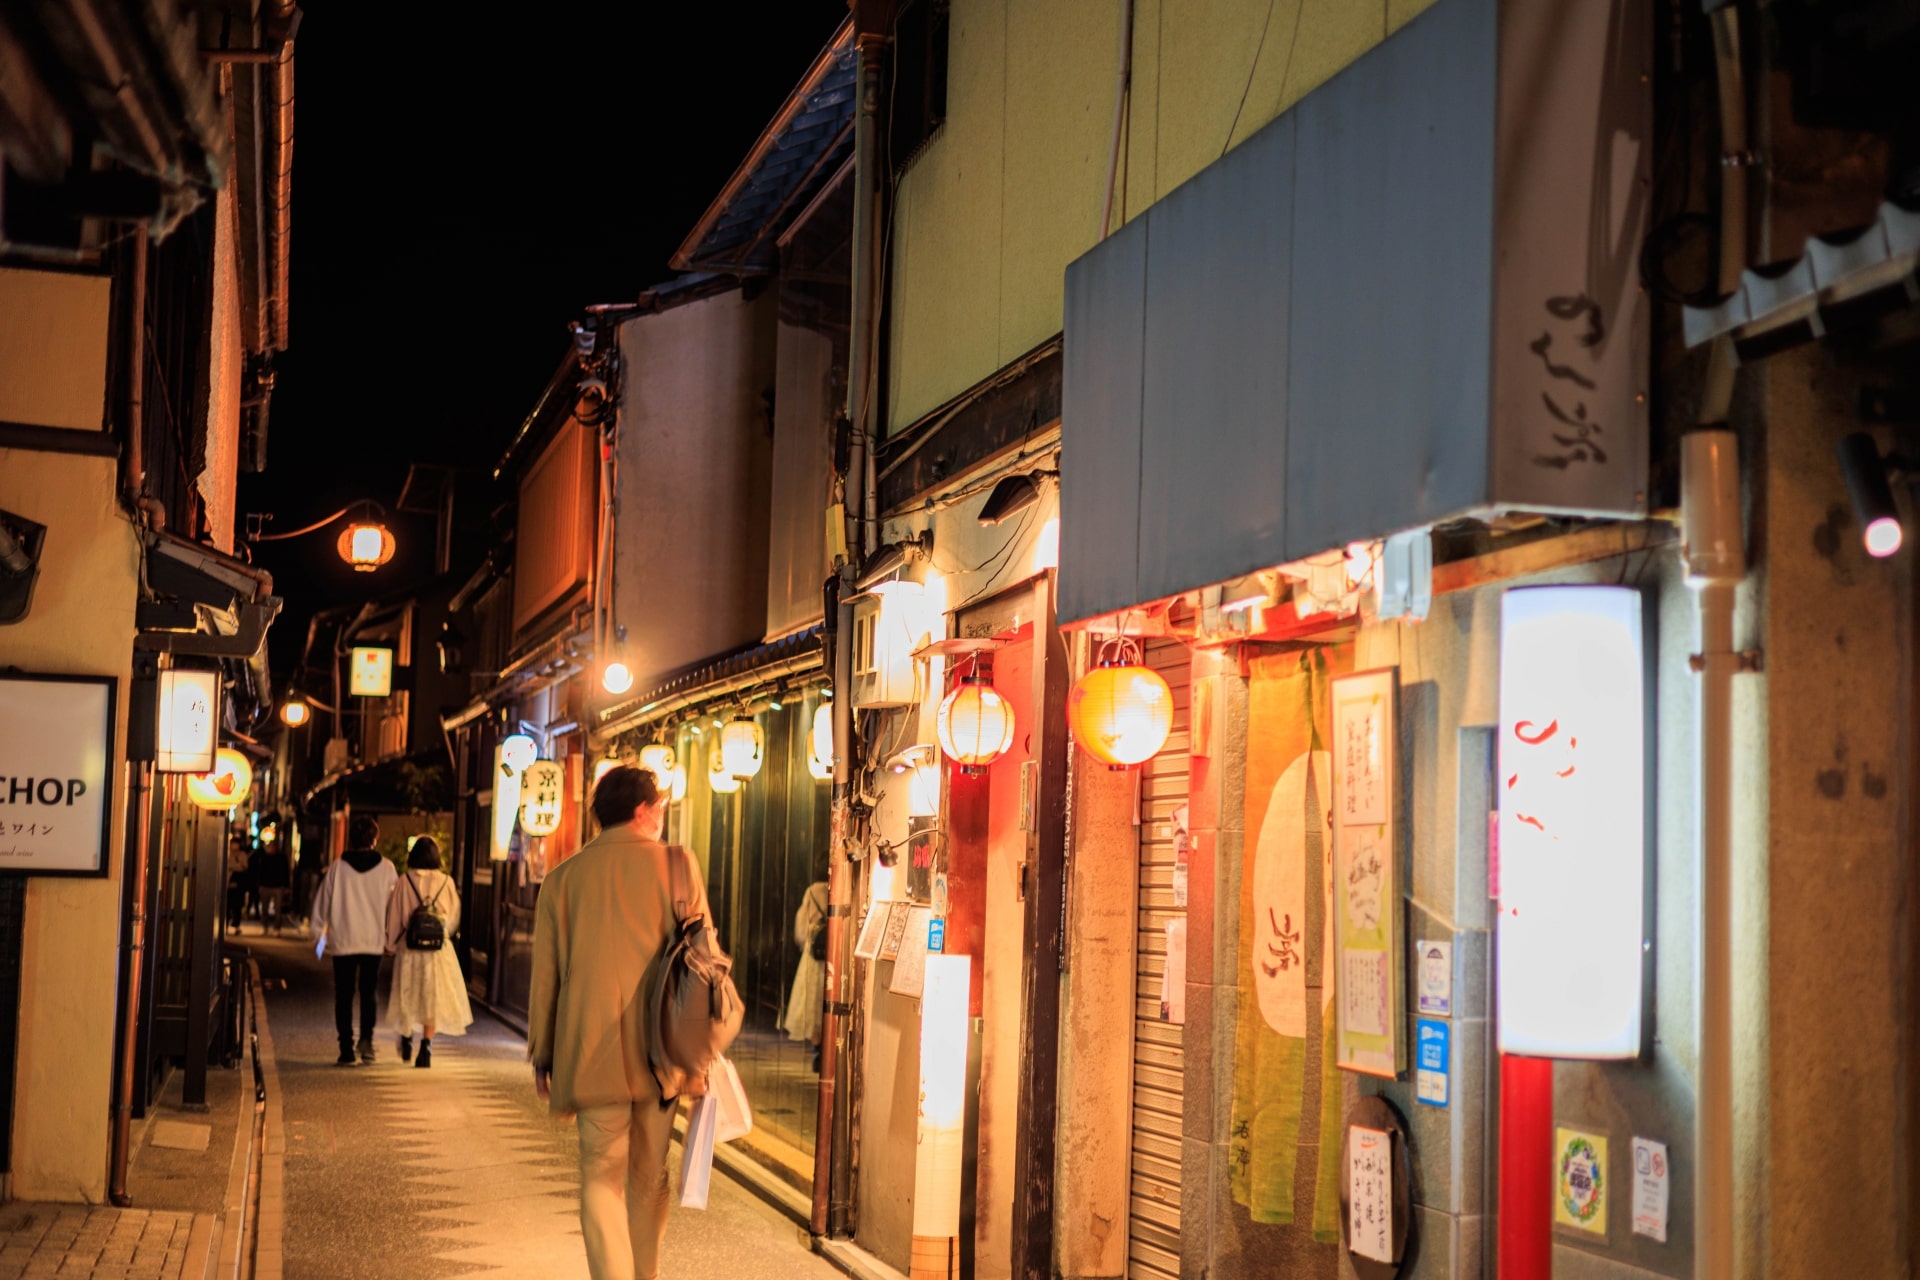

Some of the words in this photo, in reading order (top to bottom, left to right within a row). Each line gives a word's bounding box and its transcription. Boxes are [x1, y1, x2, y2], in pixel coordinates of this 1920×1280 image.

[0, 776, 87, 807] HOP
[535, 768, 557, 826] 京料理
